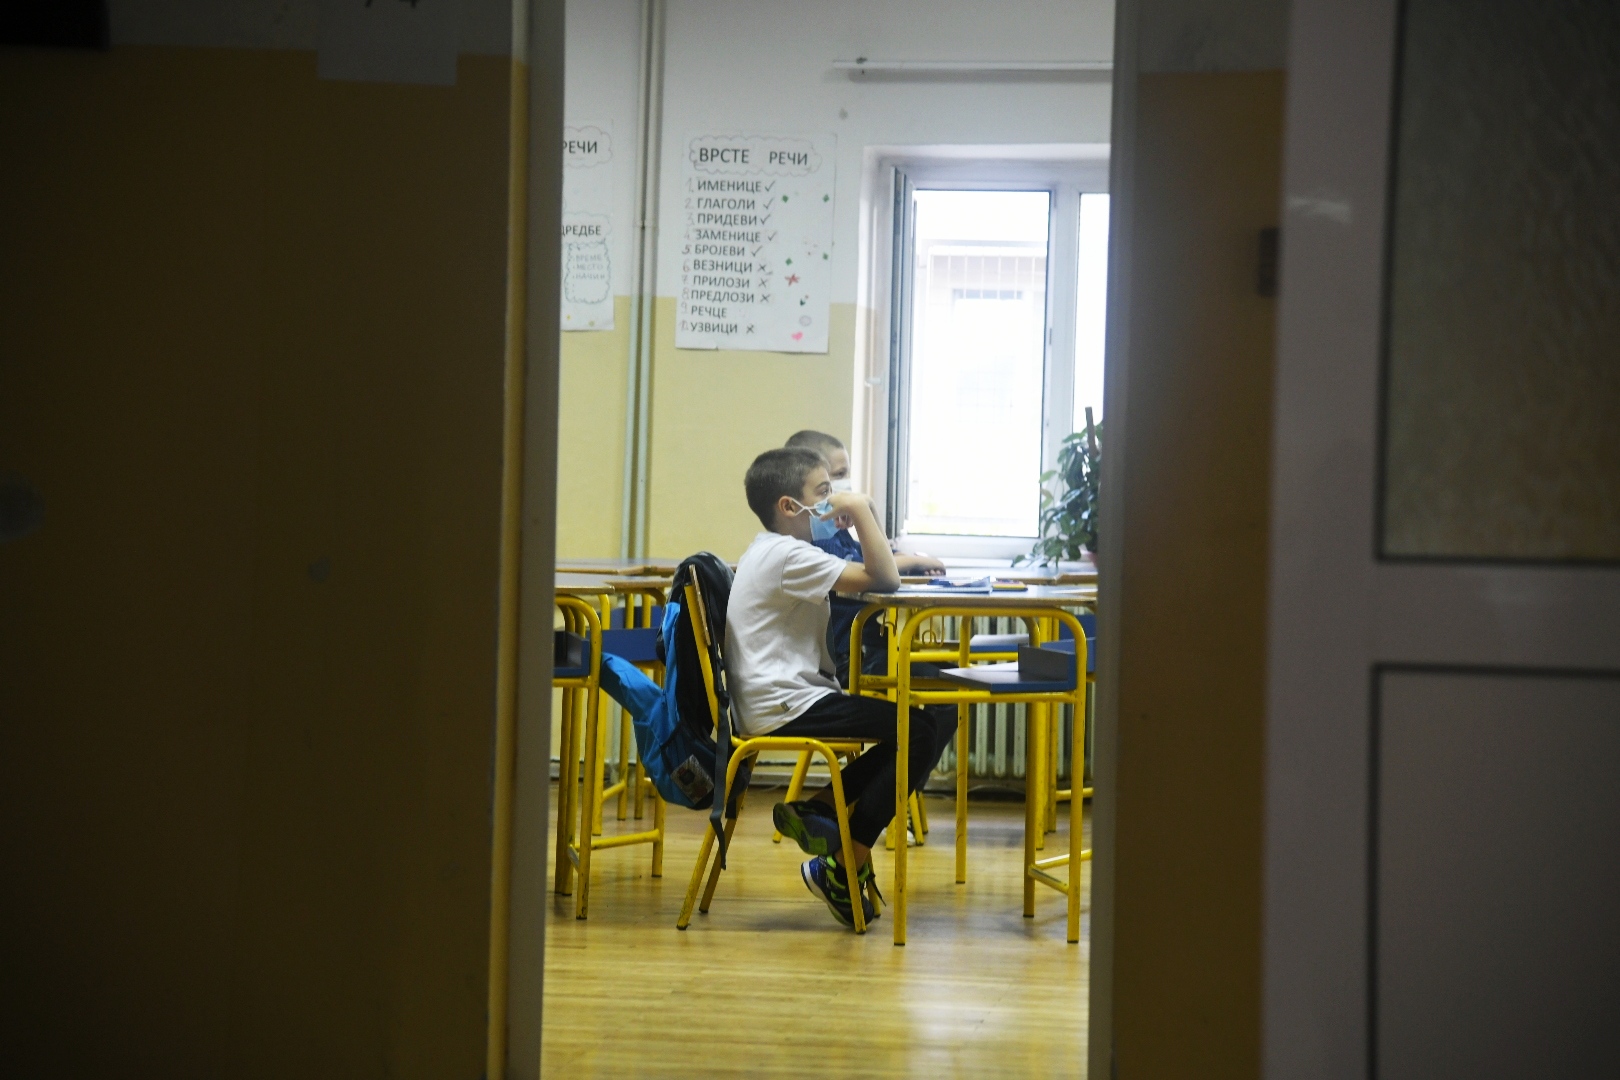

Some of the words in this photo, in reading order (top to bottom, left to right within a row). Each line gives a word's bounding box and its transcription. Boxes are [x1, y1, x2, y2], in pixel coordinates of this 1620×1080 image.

[699, 147, 750, 164] ВРСТЕ
[769, 151, 808, 166] РЕЧИ
[697, 180, 762, 194] ИМЕНИЦЕ
[697, 197, 755, 210] ГЛАГОЛИ
[697, 213, 757, 227] ПРИДЕВИ
[695, 229, 761, 244] ЗАМЕНИЦЕ
[694, 244, 745, 257] БРОЈЕВИ
[693, 259, 752, 274] ВЕЗНИЦИ
[693, 275, 750, 289] ПРИЛОЗИ
[691, 289, 755, 303] ПРЕДЛОЗИ
[691, 305, 727, 319] РЕЧЦЕ
[690, 321, 738, 336] УЗВИЦИ
